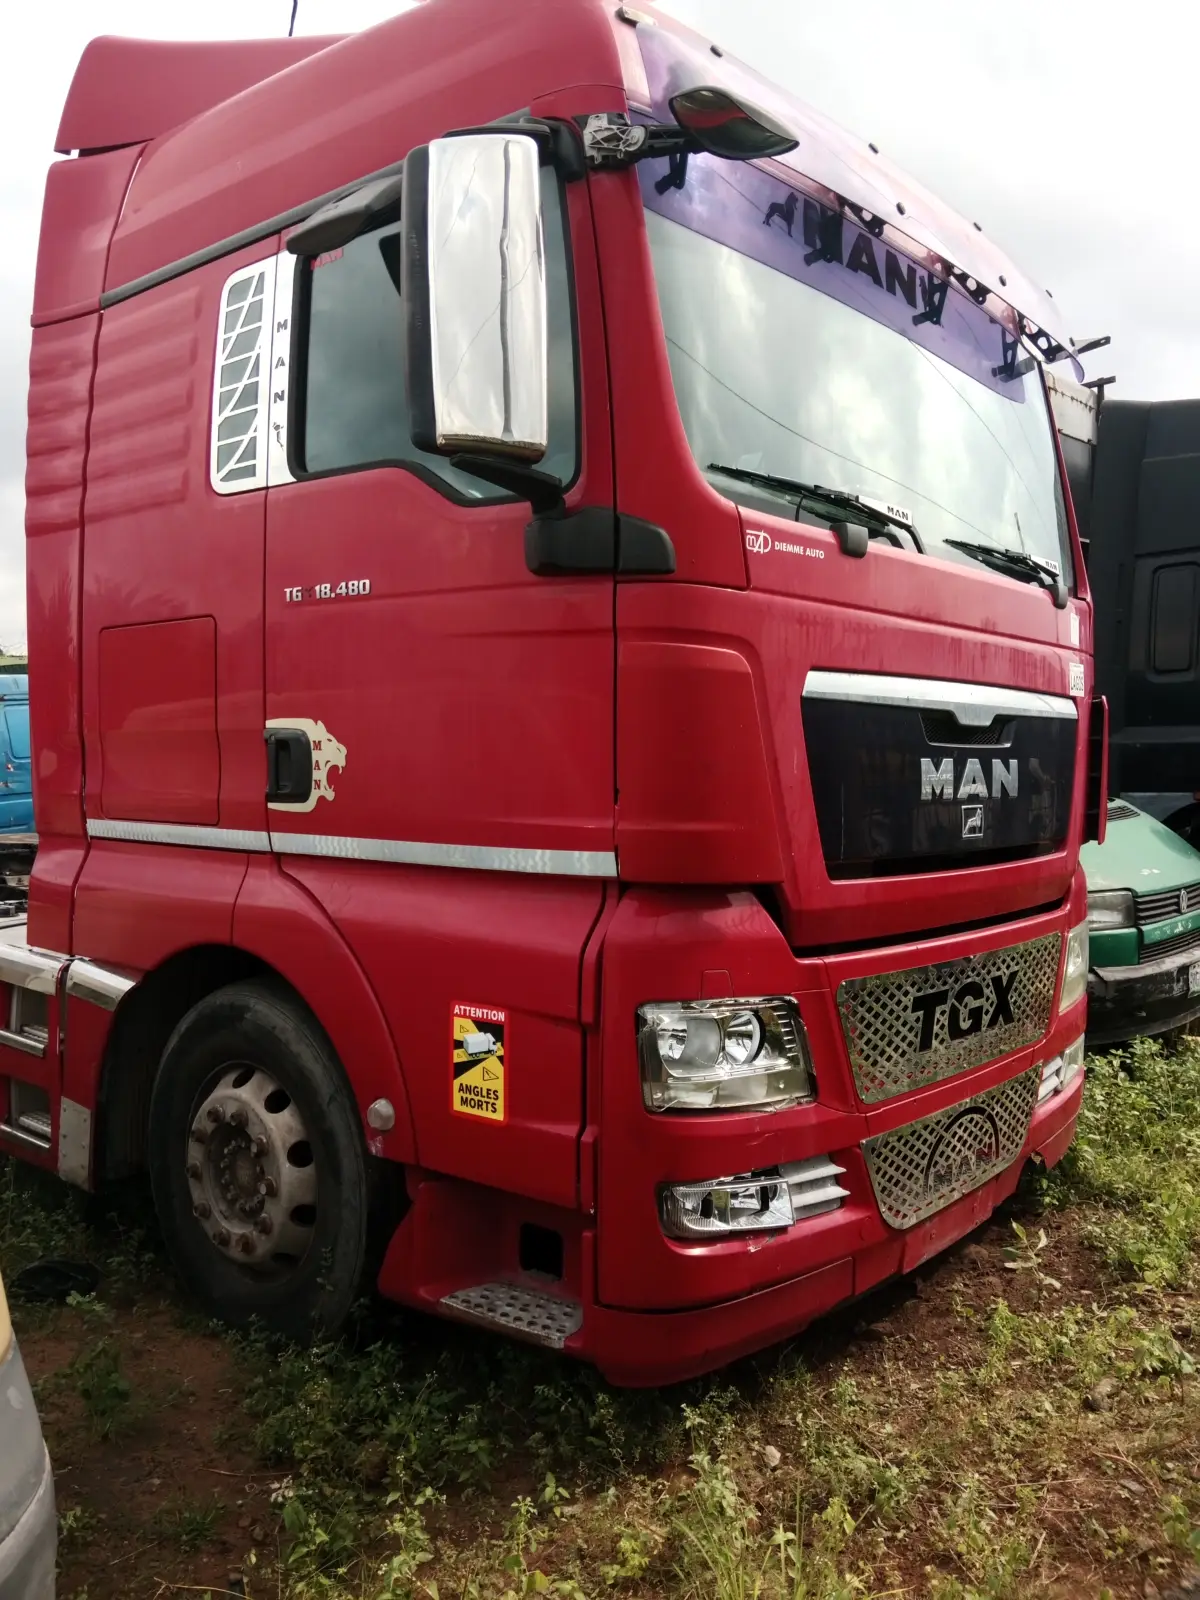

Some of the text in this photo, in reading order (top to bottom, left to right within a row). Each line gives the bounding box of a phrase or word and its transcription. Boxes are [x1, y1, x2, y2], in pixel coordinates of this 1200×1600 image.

[274, 319, 288, 403] MAN
[887, 505, 909, 521] MAN
[774, 541, 804, 555] DIEMME
[805, 547, 825, 559] AUTO
[314, 579, 370, 599] 18.480
[312, 740, 322, 790] MAN
[920, 758, 1018, 800] MAN
[454, 1004, 505, 1021] ATTENTION
[911, 970, 1020, 1052] TGX
[458, 1083, 499, 1101] ANGLES
[460, 1096, 497, 1113] MORTS
